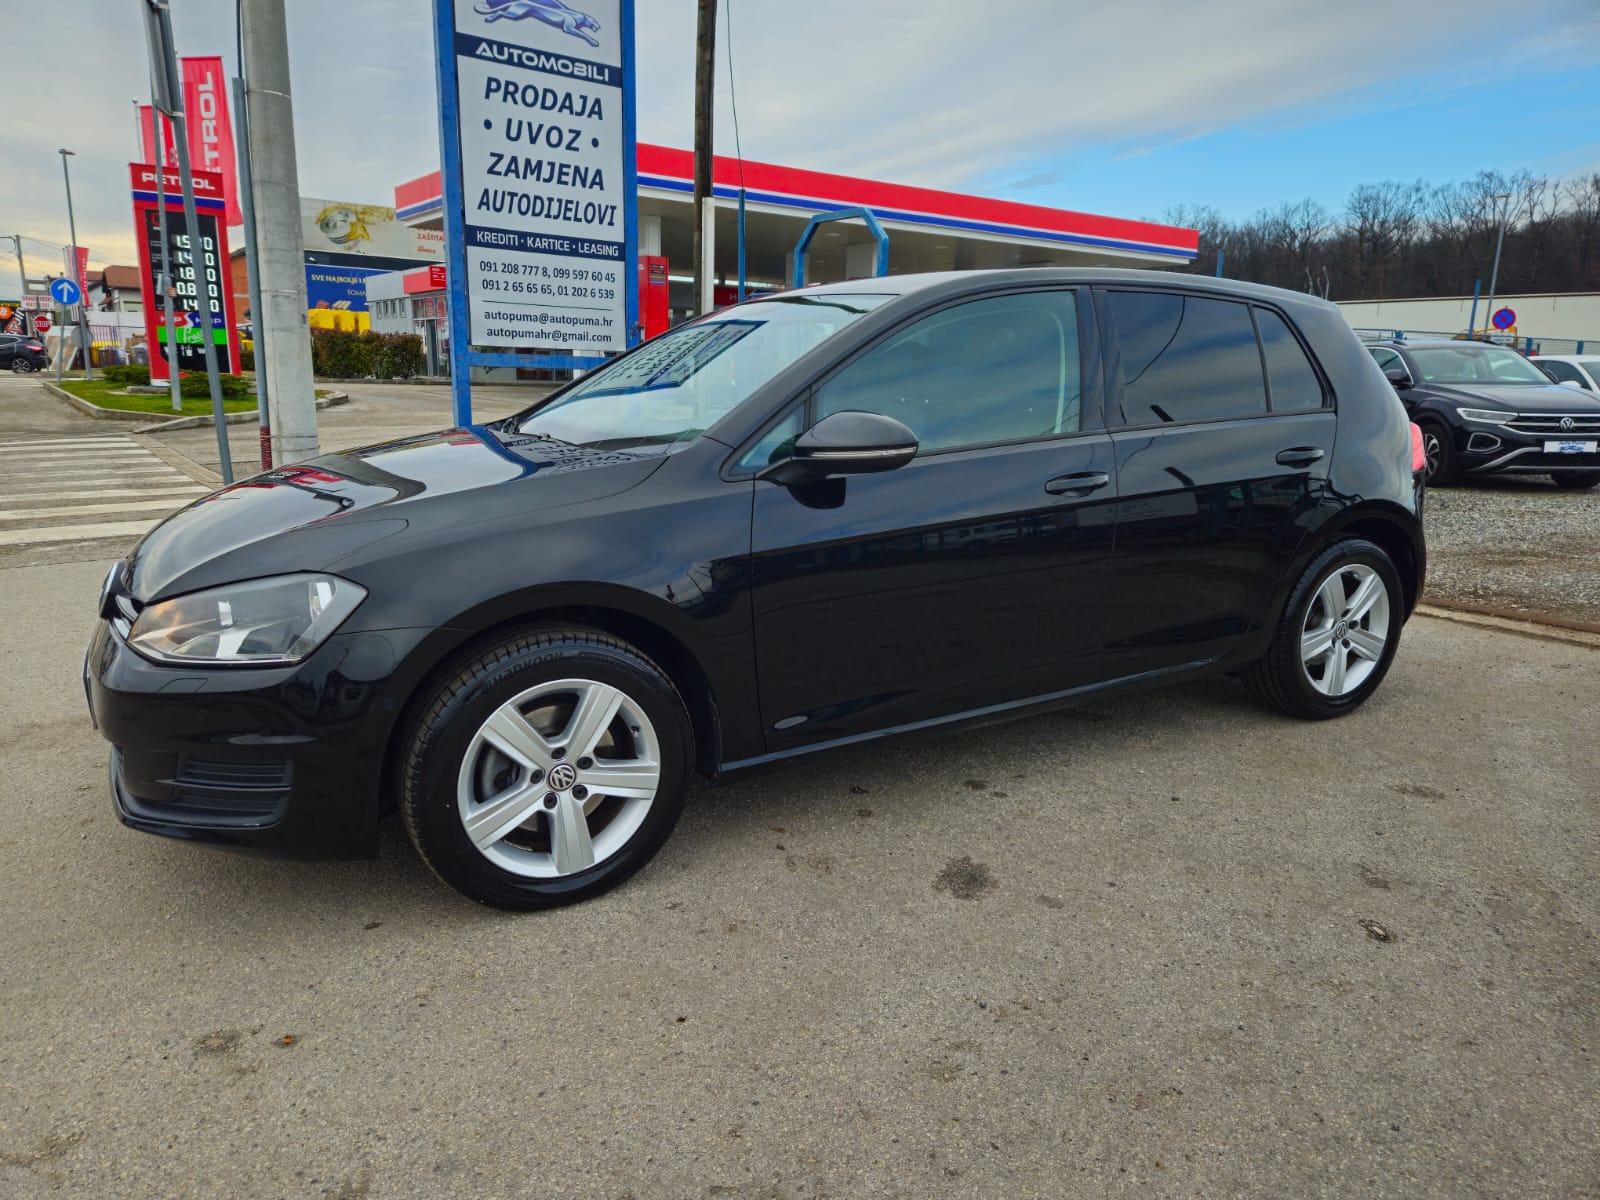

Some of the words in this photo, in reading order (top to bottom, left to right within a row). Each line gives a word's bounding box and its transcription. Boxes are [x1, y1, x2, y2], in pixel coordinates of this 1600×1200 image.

[475, 41, 609, 82] AUTOMOBILI
[484, 76, 604, 120] PRODAJA
[198, 72, 221, 173] TROL
[505, 117, 582, 152] UVOZ
[141, 172, 216, 191] PETOL
[486, 152, 605, 191] ZAMJENA
[477, 188, 617, 226] AUTODIJELOVI
[476, 230, 519, 247] KREDITI
[527, 236, 571, 252] KARTICE
[578, 242, 619, 257] LEASING
[479, 260, 498, 273] 091
[500, 262, 520, 275] 208
[521, 265, 540, 277] 777
[541, 266, 551, 279] 8,
[552, 267, 571, 280] 099
[572, 269, 590, 281] 597
[591, 271, 603, 282] 60
[604, 272, 616, 283] 45
[482, 279, 501, 291] 091
[503, 281, 510, 292] 2
[512, 282, 524, 293] 65
[526, 283, 538, 295] 65
[540, 284, 556, 297] 65,
[557, 285, 569, 296] 01
[571, 286, 588, 298] 202
[590, 288, 597, 298] 6
[598, 288, 615, 300] 539
[484, 311, 614, 327] autopuma@autopuma.hr
[486, 327, 612, 343] autopumahr@gmail.com
